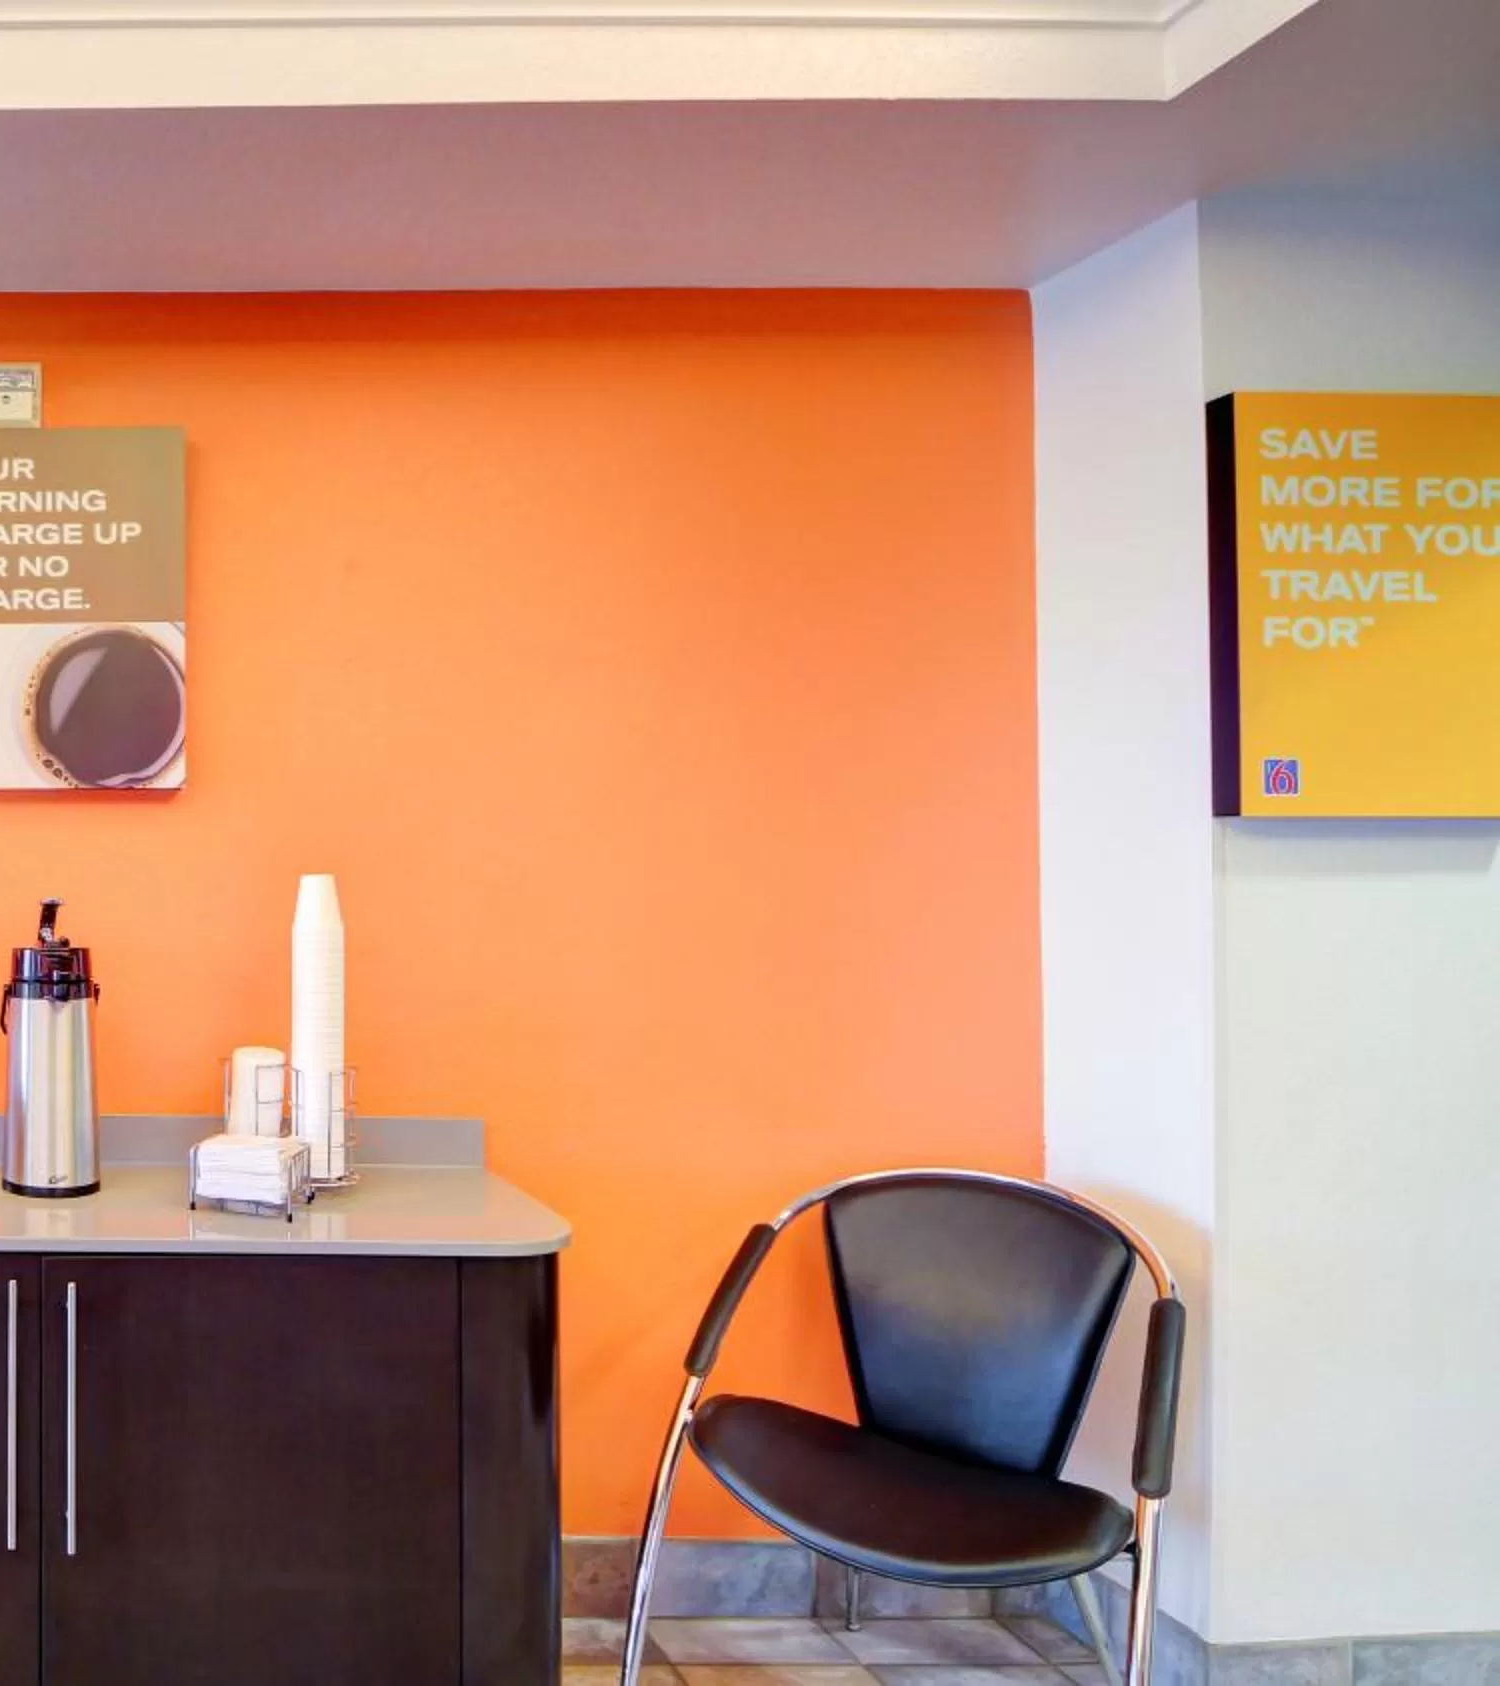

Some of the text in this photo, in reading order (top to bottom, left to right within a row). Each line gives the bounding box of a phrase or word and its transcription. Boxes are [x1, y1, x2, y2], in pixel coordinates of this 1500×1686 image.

[1259, 427, 1378, 460] SAVE
[1259, 475, 1400, 508] MORE
[94, 522, 142, 545] UP
[1259, 522, 1500, 557] WHAT YOU
[18, 555, 70, 578] NO
[1260, 569, 1437, 603] TRAVEL
[1268, 758, 1296, 796] 6
